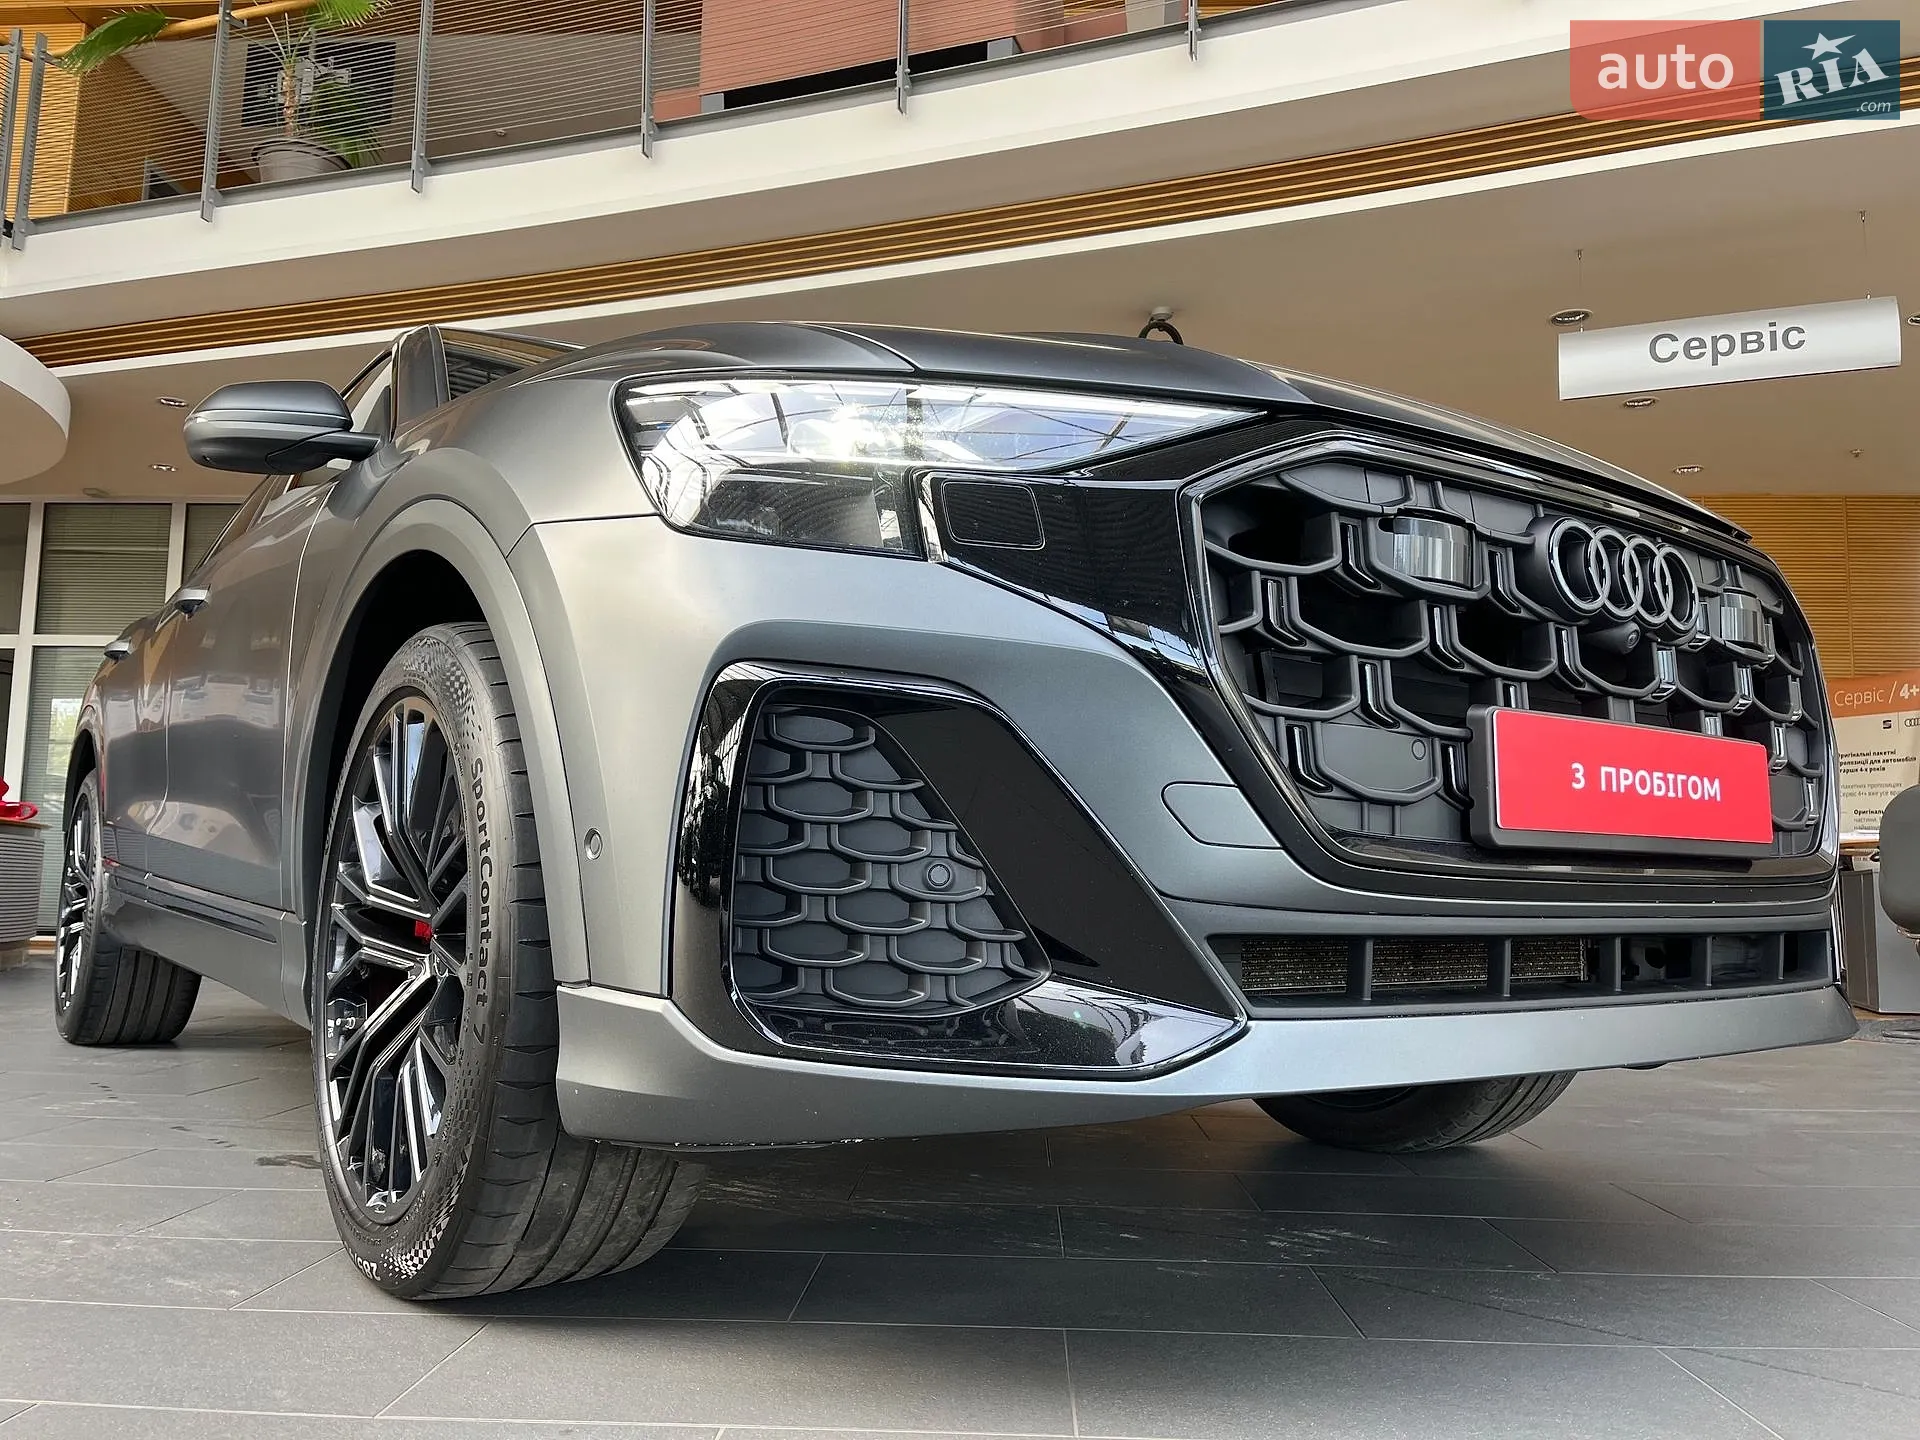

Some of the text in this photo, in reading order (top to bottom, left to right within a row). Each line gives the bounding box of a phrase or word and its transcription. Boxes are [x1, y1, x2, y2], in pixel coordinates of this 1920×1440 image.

[1649, 321, 1806, 366] Сервіс
[1834, 687, 1885, 709] Сервіс
[1839, 757, 1869, 766] ропозиції
[1600, 766, 1721, 802] ПРОБІГОМ
[471, 757, 493, 1045] SportContact 7
